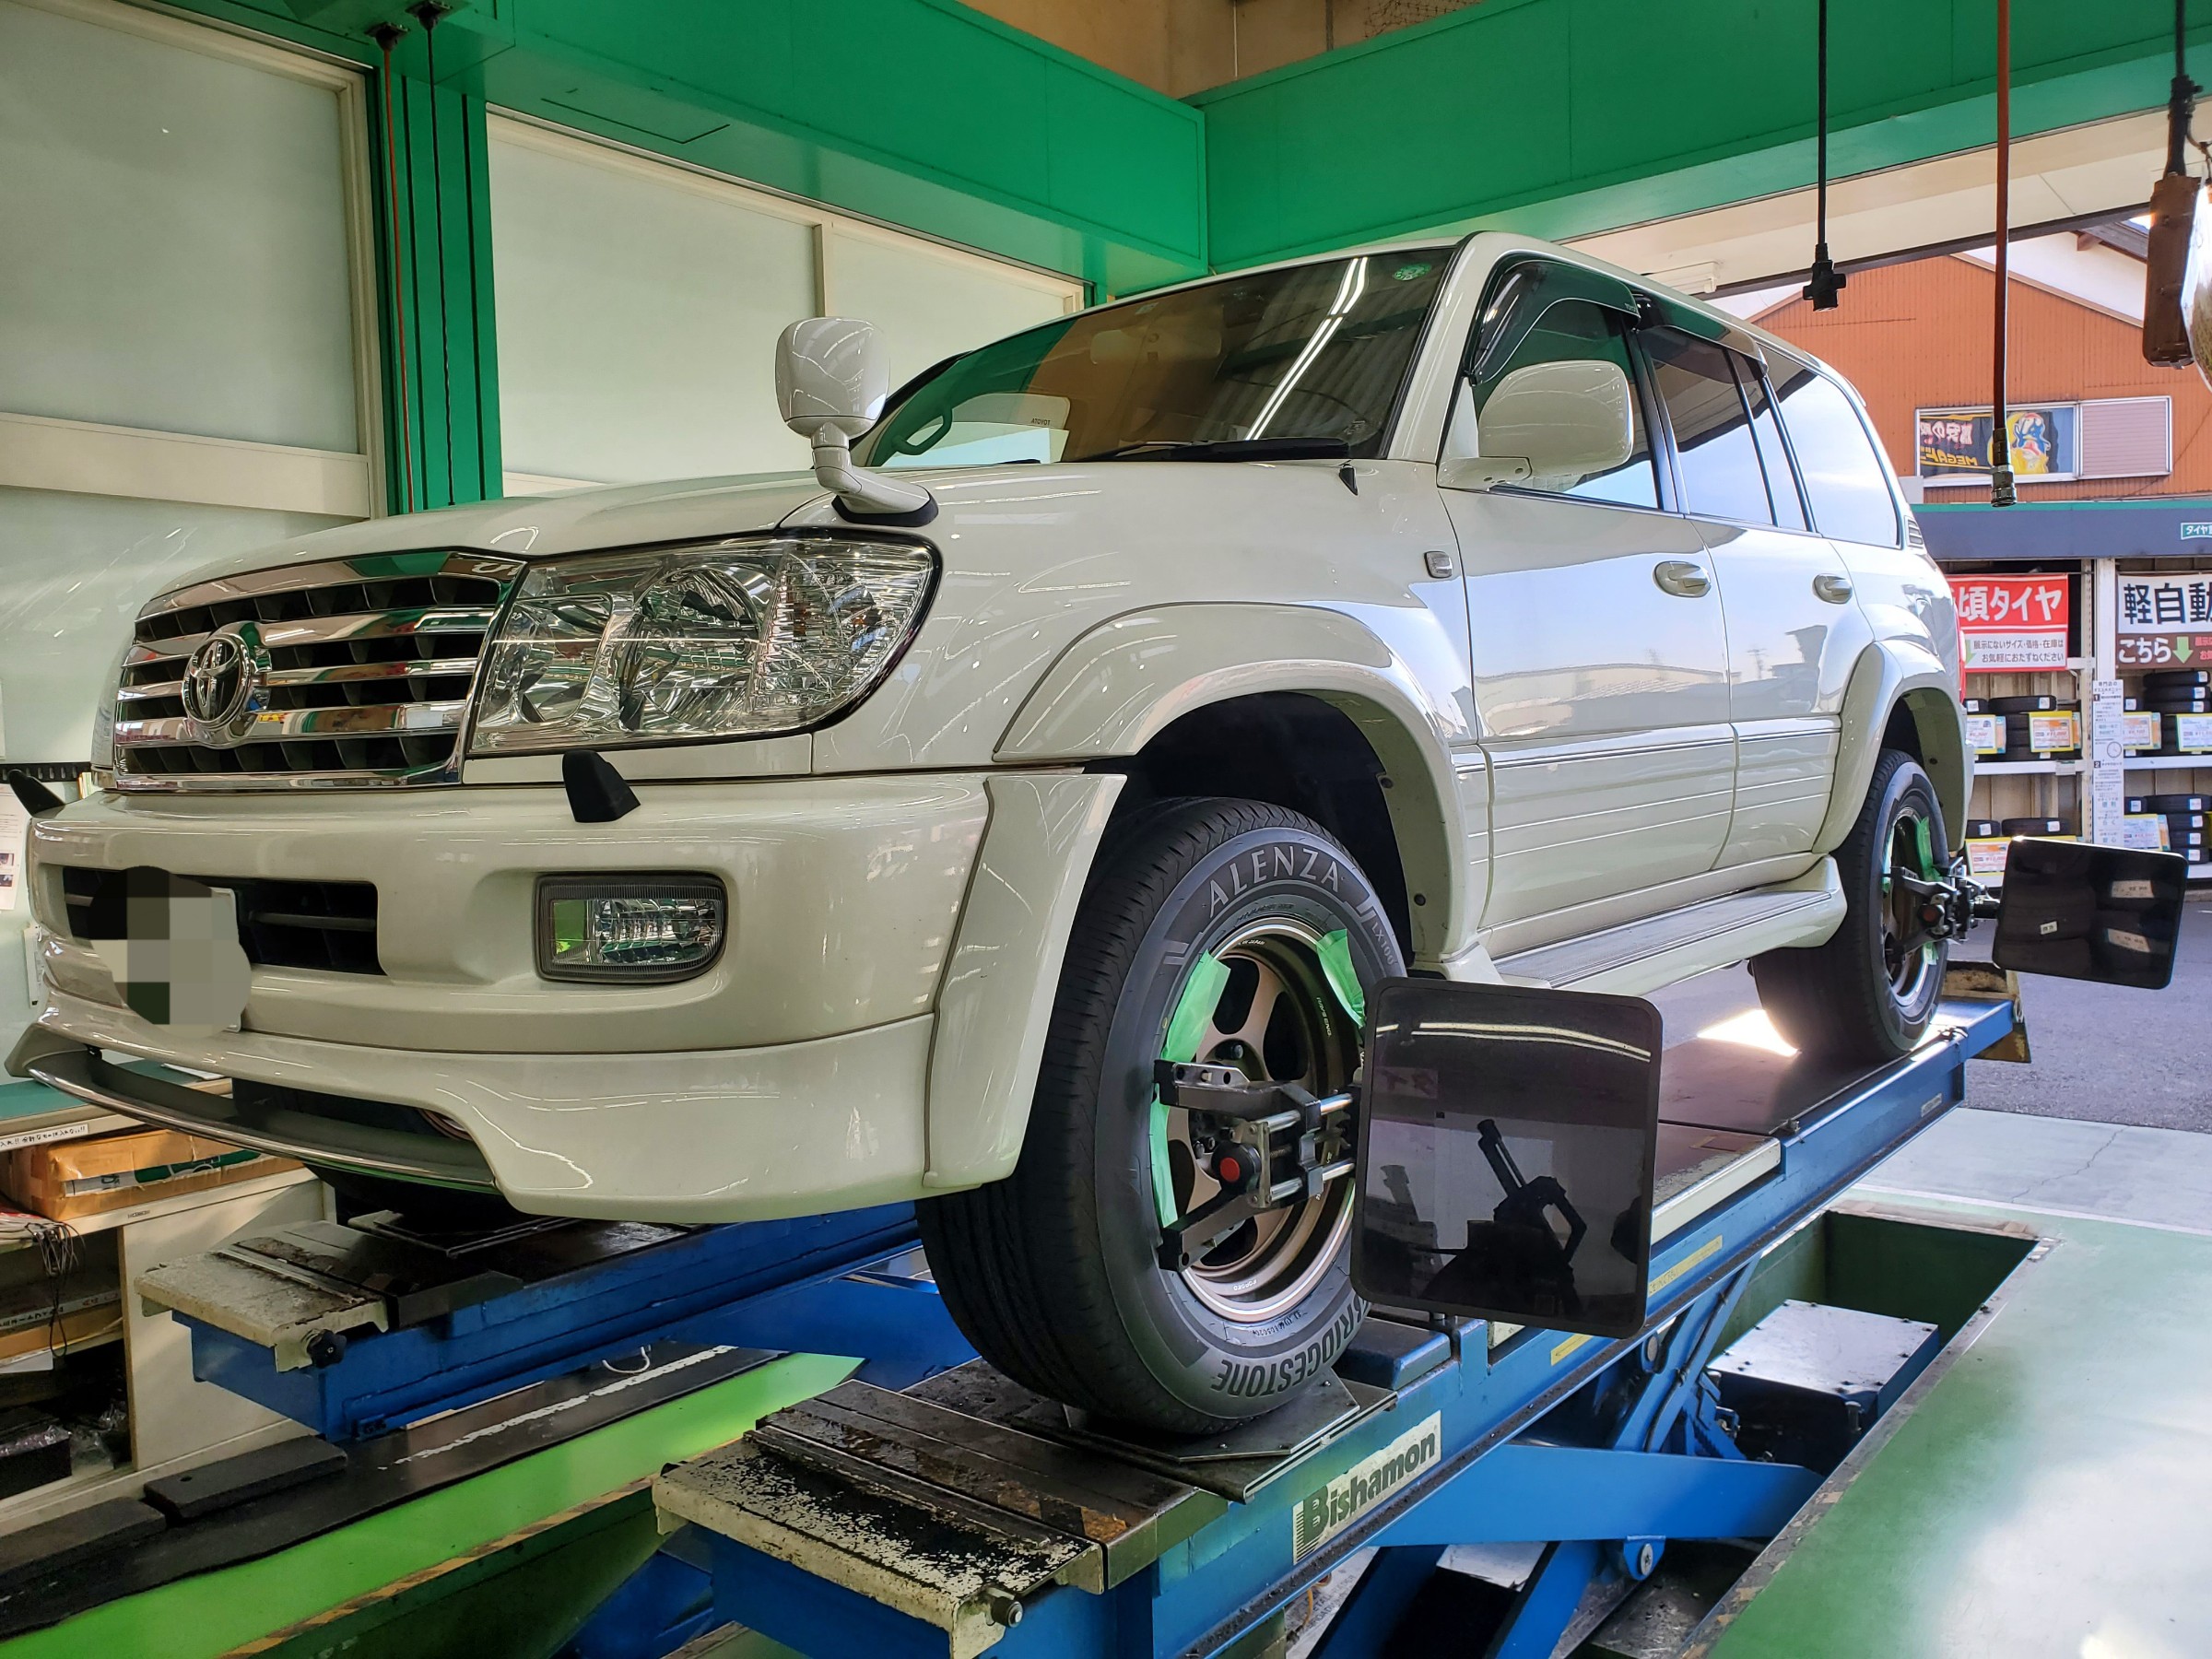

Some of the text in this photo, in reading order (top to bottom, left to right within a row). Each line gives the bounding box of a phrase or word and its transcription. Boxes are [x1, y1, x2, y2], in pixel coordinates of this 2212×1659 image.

[1951, 584, 2063, 622] 頃タイヤ
[1982, 653, 2064, 663] お気軽におたずねください
[2118, 637, 2172, 664] こちら
[1207, 845, 1343, 918] ALENZA
[1371, 922, 1394, 965] LX100
[1211, 1298, 1371, 1398] BRIDGESTONE
[1298, 1431, 1436, 1550] Bishamon
